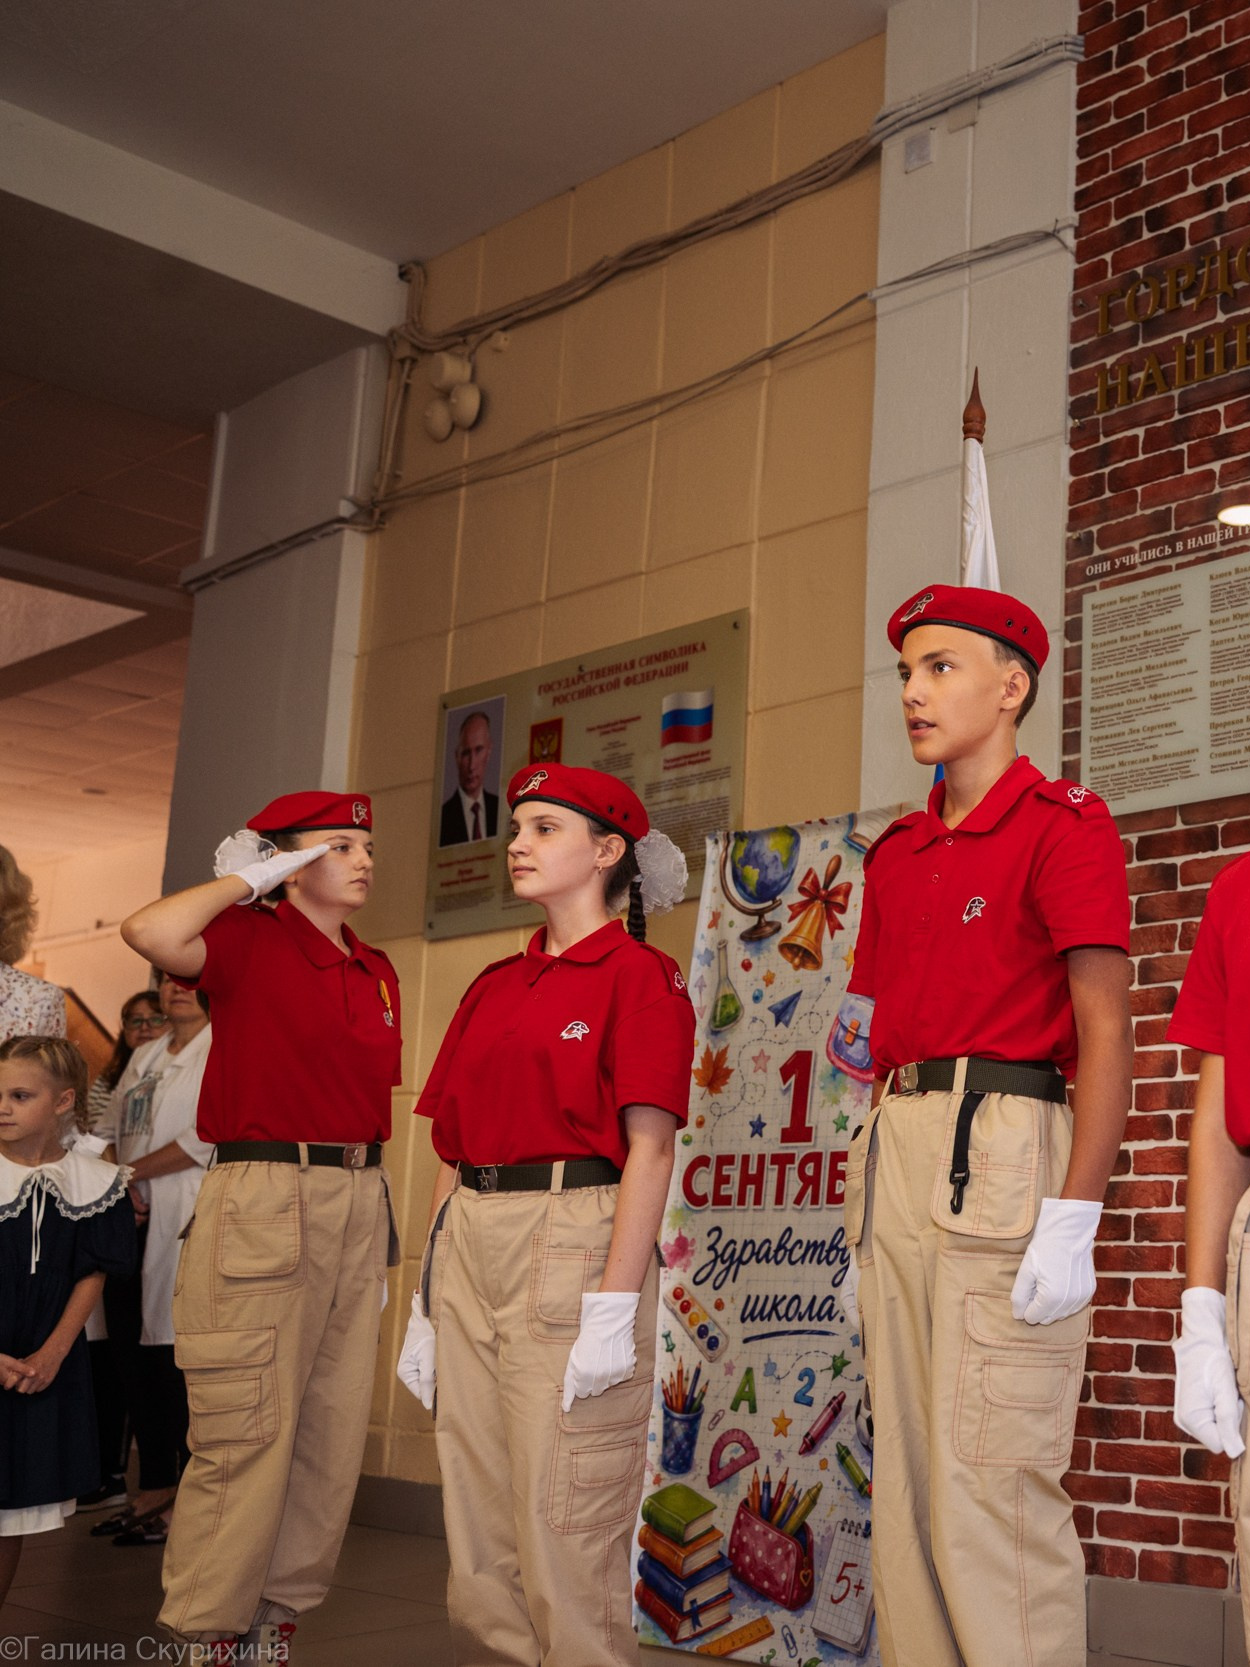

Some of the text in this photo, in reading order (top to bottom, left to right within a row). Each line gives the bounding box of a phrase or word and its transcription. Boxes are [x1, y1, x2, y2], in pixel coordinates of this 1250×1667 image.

[1085, 561, 1111, 577] ОНИ
[1114, 545, 1172, 570] УЧИЛИСЬ
[1175, 541, 1184, 552] В
[1186, 526, 1235, 549] НАШЕЙ
[537, 641, 707, 696] ГОСУДАРСТВЕННАЯ СИМВОЛИКА
[552, 660, 689, 707] РОССИЙСКОЙ ФЕДЕРАЦИИ
[778, 1049, 814, 1144] 1
[682, 1150, 848, 1208] СЕНТЯБ
[691, 1225, 850, 1291] Здравству
[794, 1367, 816, 1407] 2
